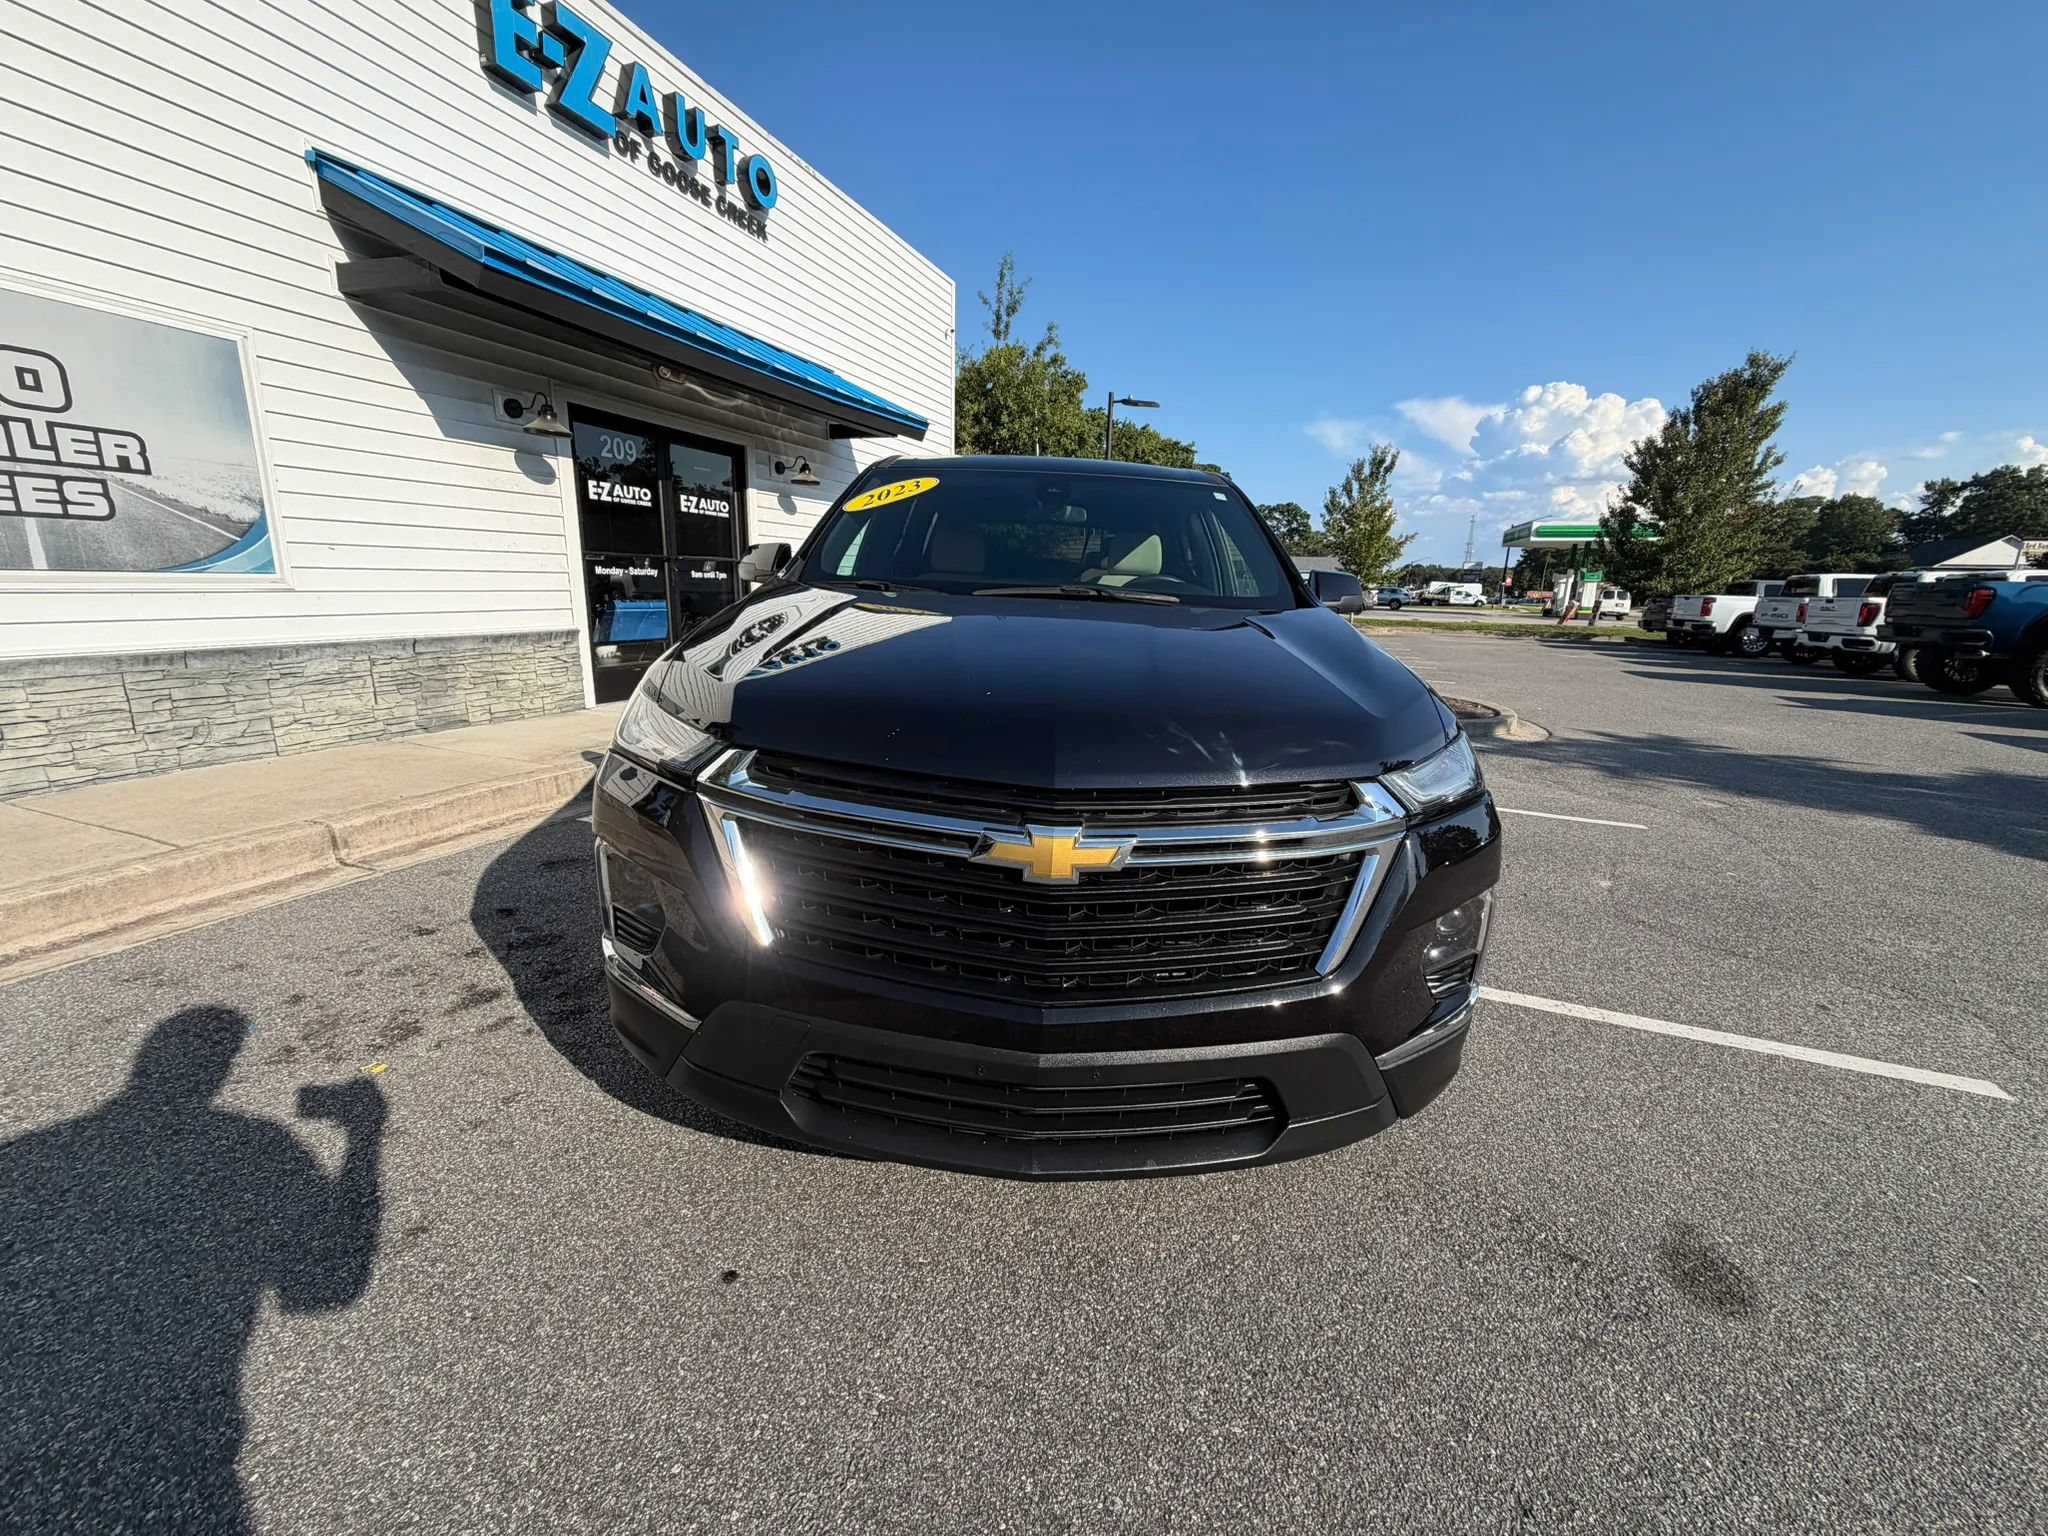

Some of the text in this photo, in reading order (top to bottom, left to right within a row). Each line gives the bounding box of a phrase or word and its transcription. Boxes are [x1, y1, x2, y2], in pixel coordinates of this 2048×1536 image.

[613, 61, 779, 211] AUTO
[613, 130, 769, 243] OF GOOSE CREEK
[599, 434, 637, 462] 209
[587, 479, 652, 502] E-Z AUTO
[680, 494, 699, 514] E-Z
[699, 497, 730, 513] AUTO
[863, 480, 921, 508] 2023
[595, 565, 624, 577] Monday
[628, 567, 658, 578] Saturday
